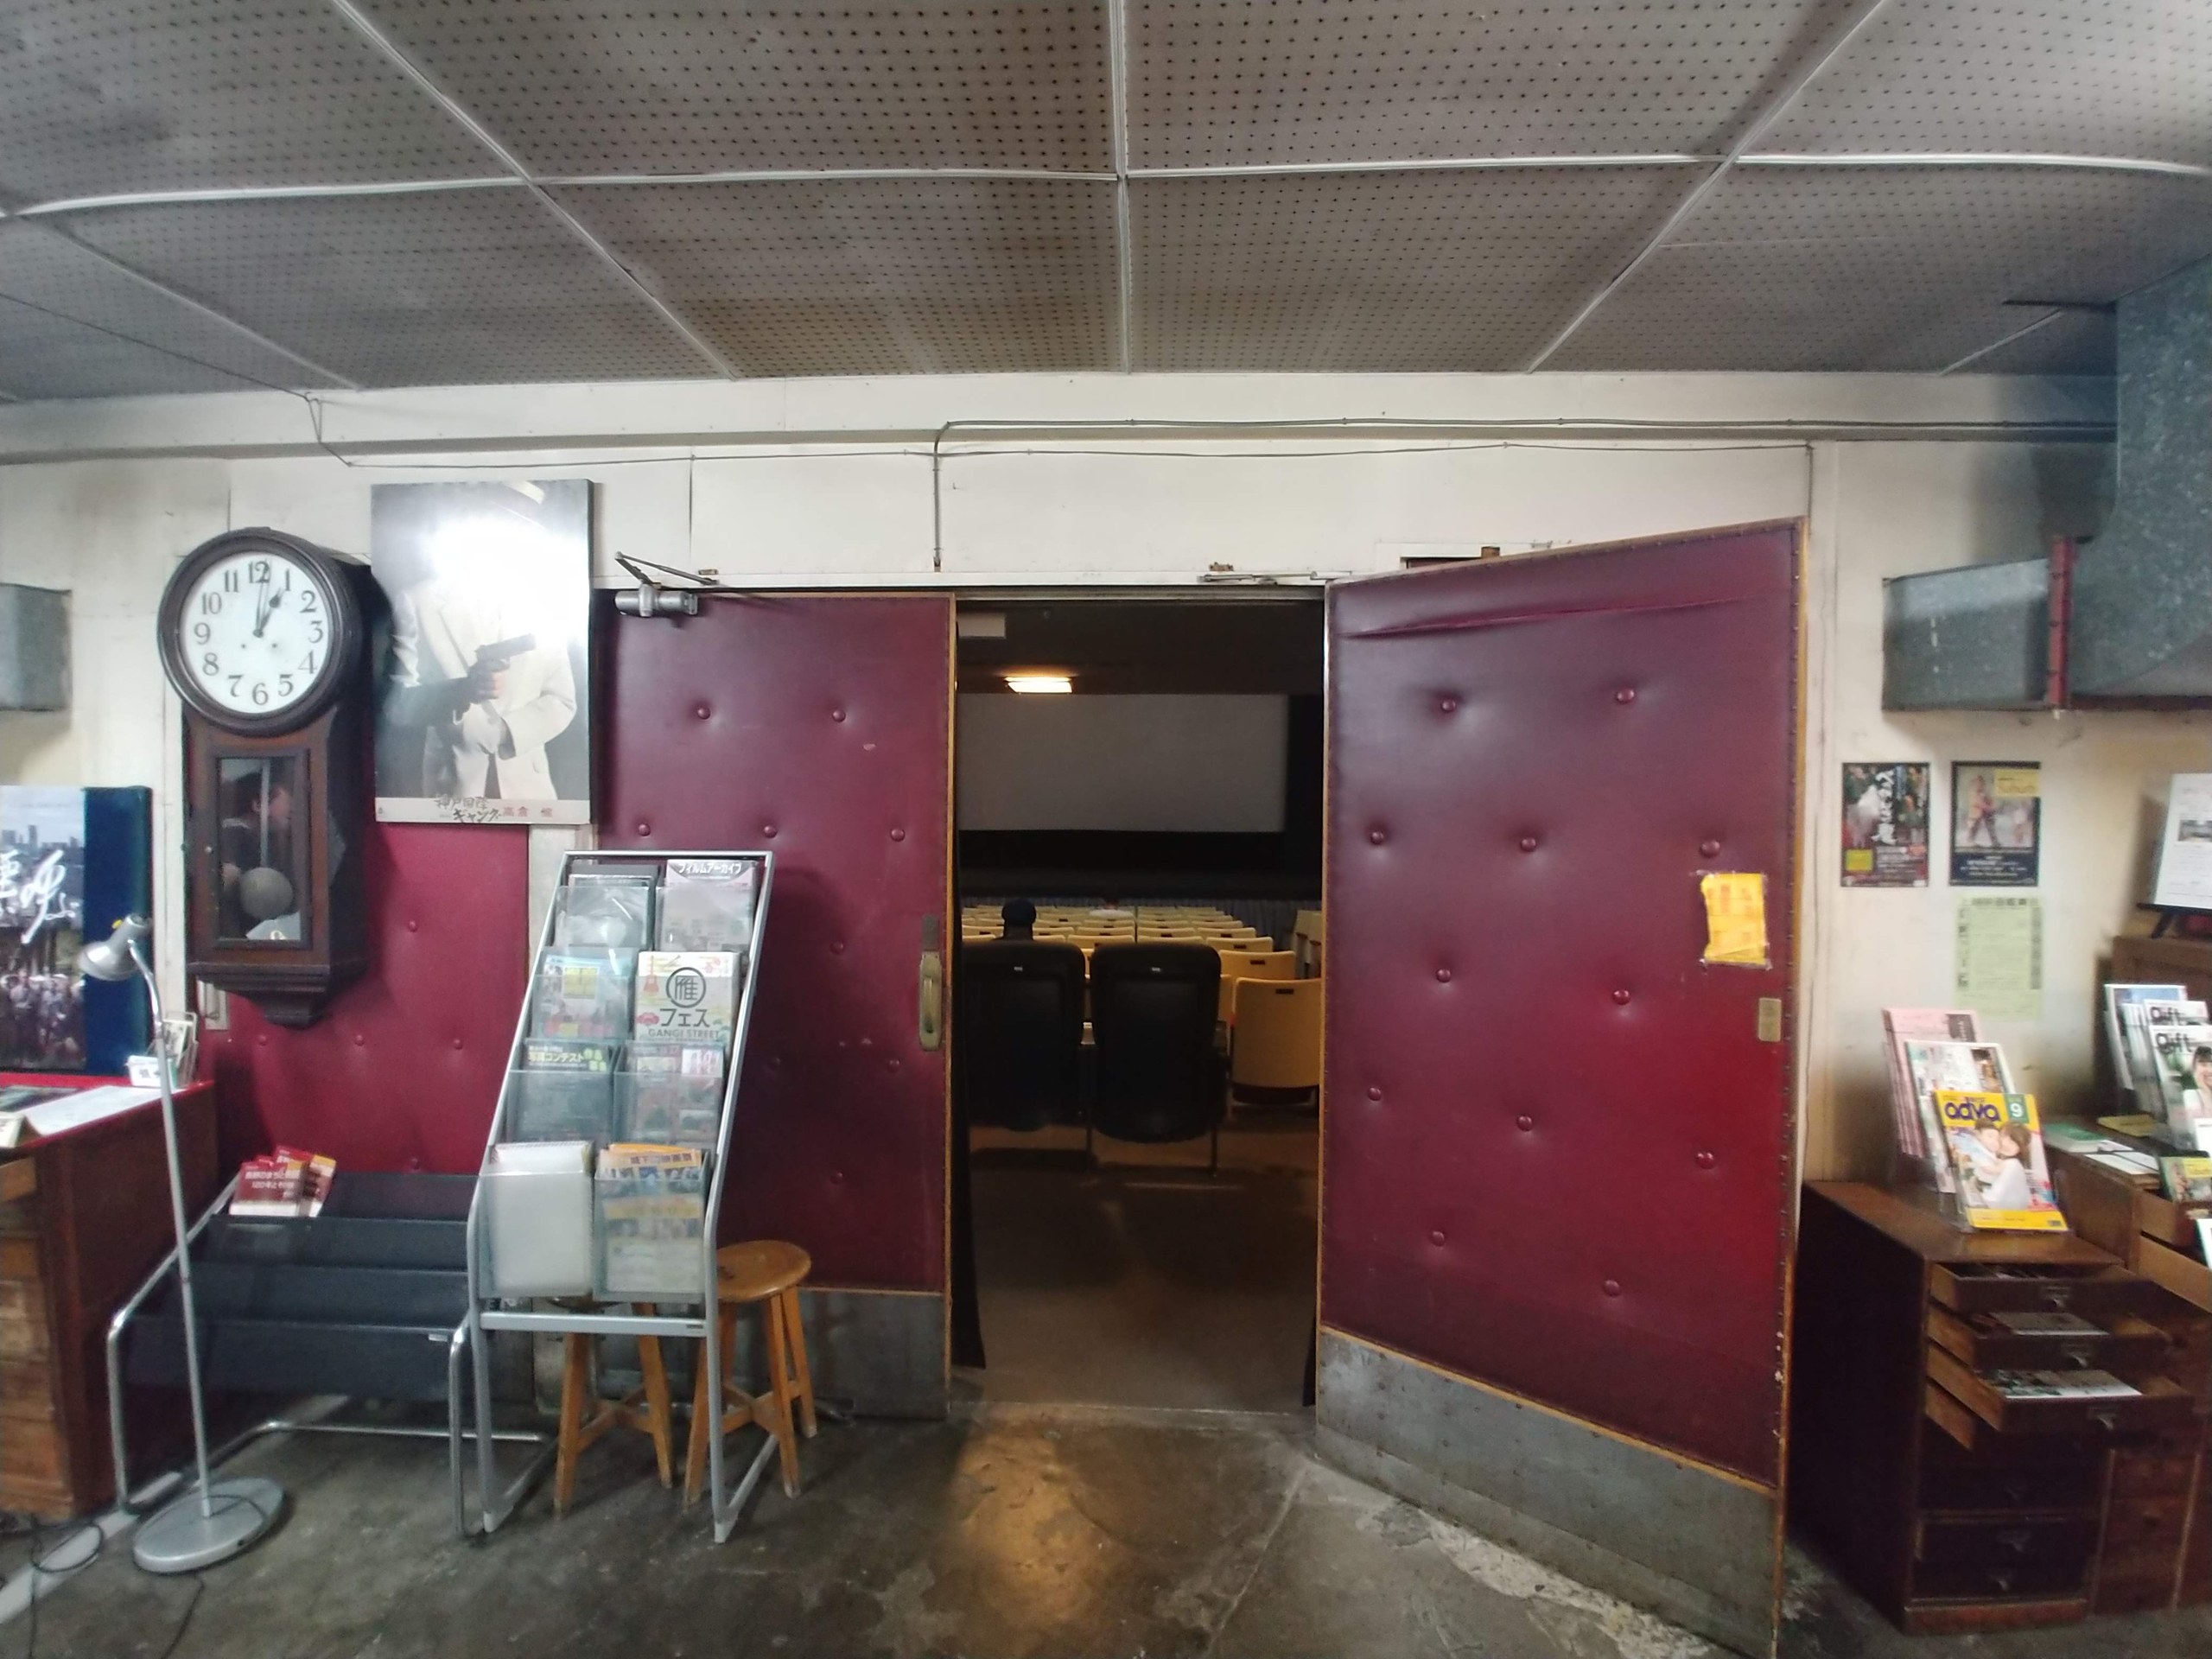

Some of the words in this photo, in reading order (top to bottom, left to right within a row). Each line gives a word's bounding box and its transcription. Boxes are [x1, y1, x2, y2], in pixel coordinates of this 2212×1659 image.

[224, 570, 238, 593] 11
[248, 561, 270, 583] 12
[284, 569, 291, 591] 1
[201, 592, 222, 614] 10
[300, 590, 317, 613] 2
[194, 622, 211, 645] 9
[308, 620, 323, 644] 3
[202, 652, 219, 676] 8
[298, 650, 317, 674] 4
[228, 674, 244, 697] 7
[251, 683, 269, 705] 6
[278, 674, 293, 696] 5
[659, 1008, 710, 1027] フェス
[2010, 1103, 2024, 1117] 9
